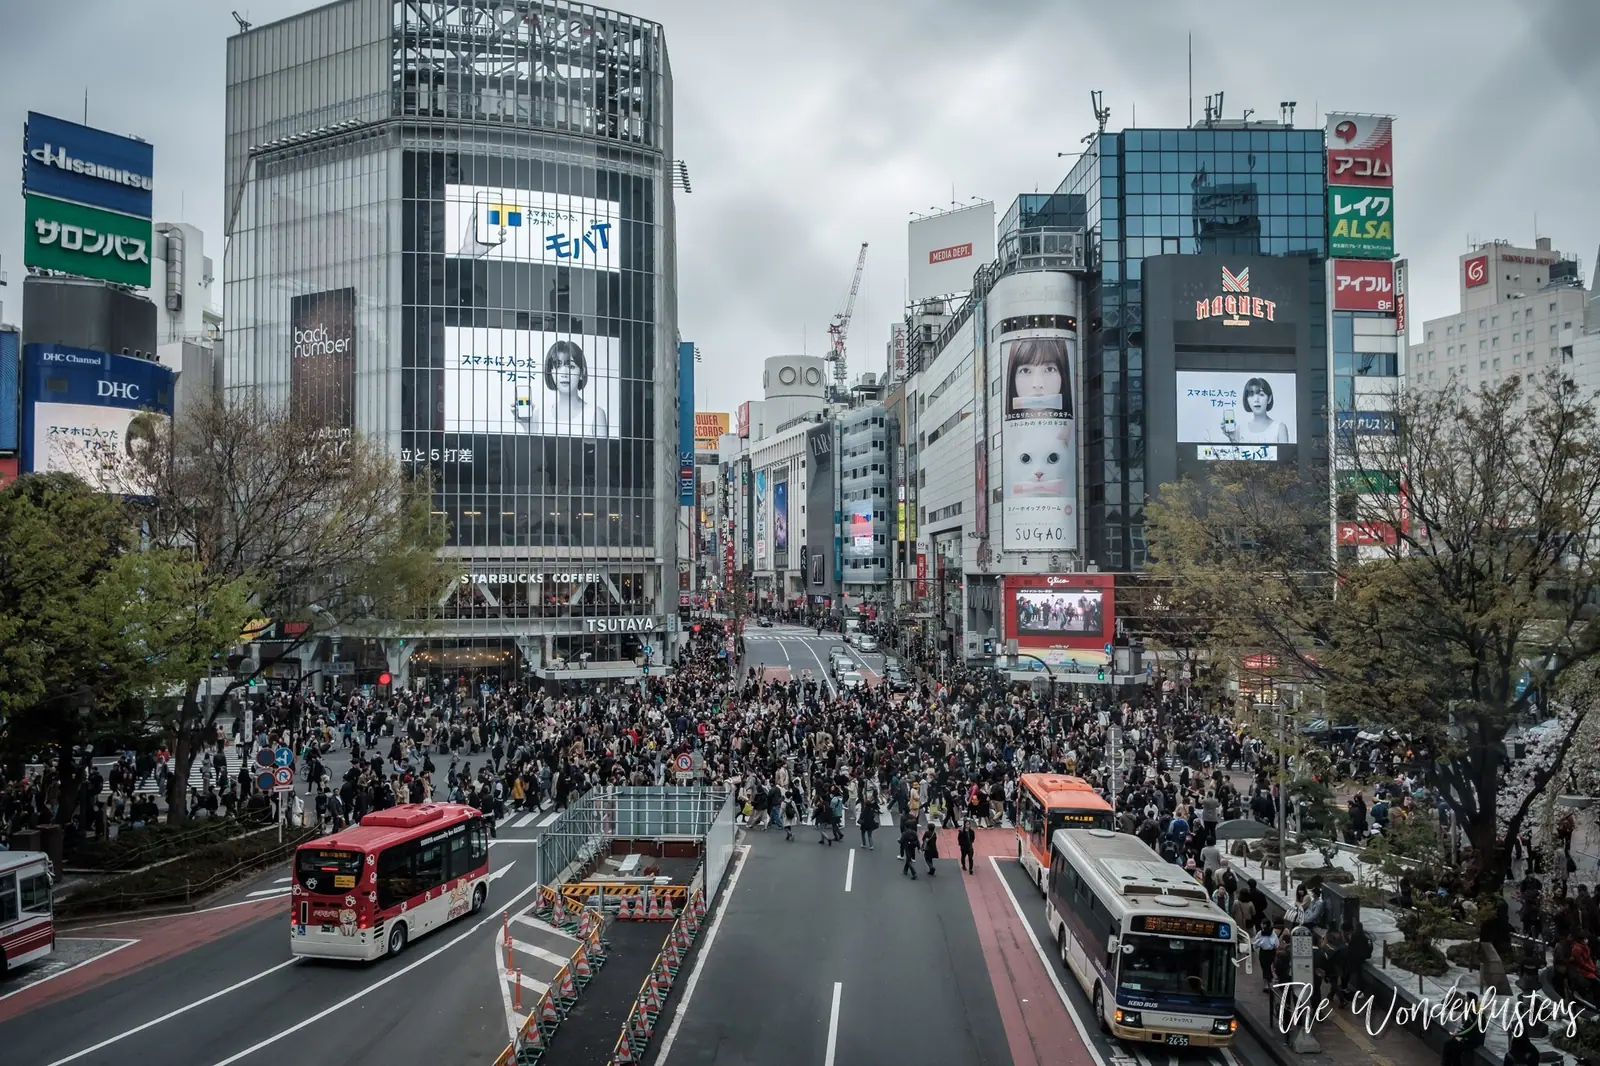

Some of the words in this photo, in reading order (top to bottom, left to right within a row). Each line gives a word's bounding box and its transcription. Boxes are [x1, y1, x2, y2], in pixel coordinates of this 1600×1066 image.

[31, 143, 153, 191] Hisamitsu
[1335, 156, 1391, 177] アコム
[1334, 194, 1390, 216] レイク
[1333, 219, 1392, 239] ALSA
[35, 218, 148, 264] サロンパス
[933, 249, 951, 262] MEDIA
[952, 246, 970, 258] DEPT.
[1336, 275, 1391, 292] アイフル
[1196, 295, 1276, 321] MAGNET
[1377, 300, 1391, 309] 8F
[295, 323, 328, 344] back
[295, 337, 350, 358] number
[43, 352, 65, 362] DHC
[66, 354, 101, 365] Channel
[462, 355, 536, 369] スマホに入った
[97, 380, 139, 400] DHC
[1187, 389, 1237, 398] スマホに入った
[695, 414, 719, 426] OWER
[50, 426, 118, 439] スマホに入った
[695, 426, 724, 437] ECORDS
[461, 574, 543, 584] STARBUCKS
[552, 574, 599, 583] COFFEE
[1047, 577, 1069, 586] Glico
[586, 618, 653, 632] TSUTAYA
